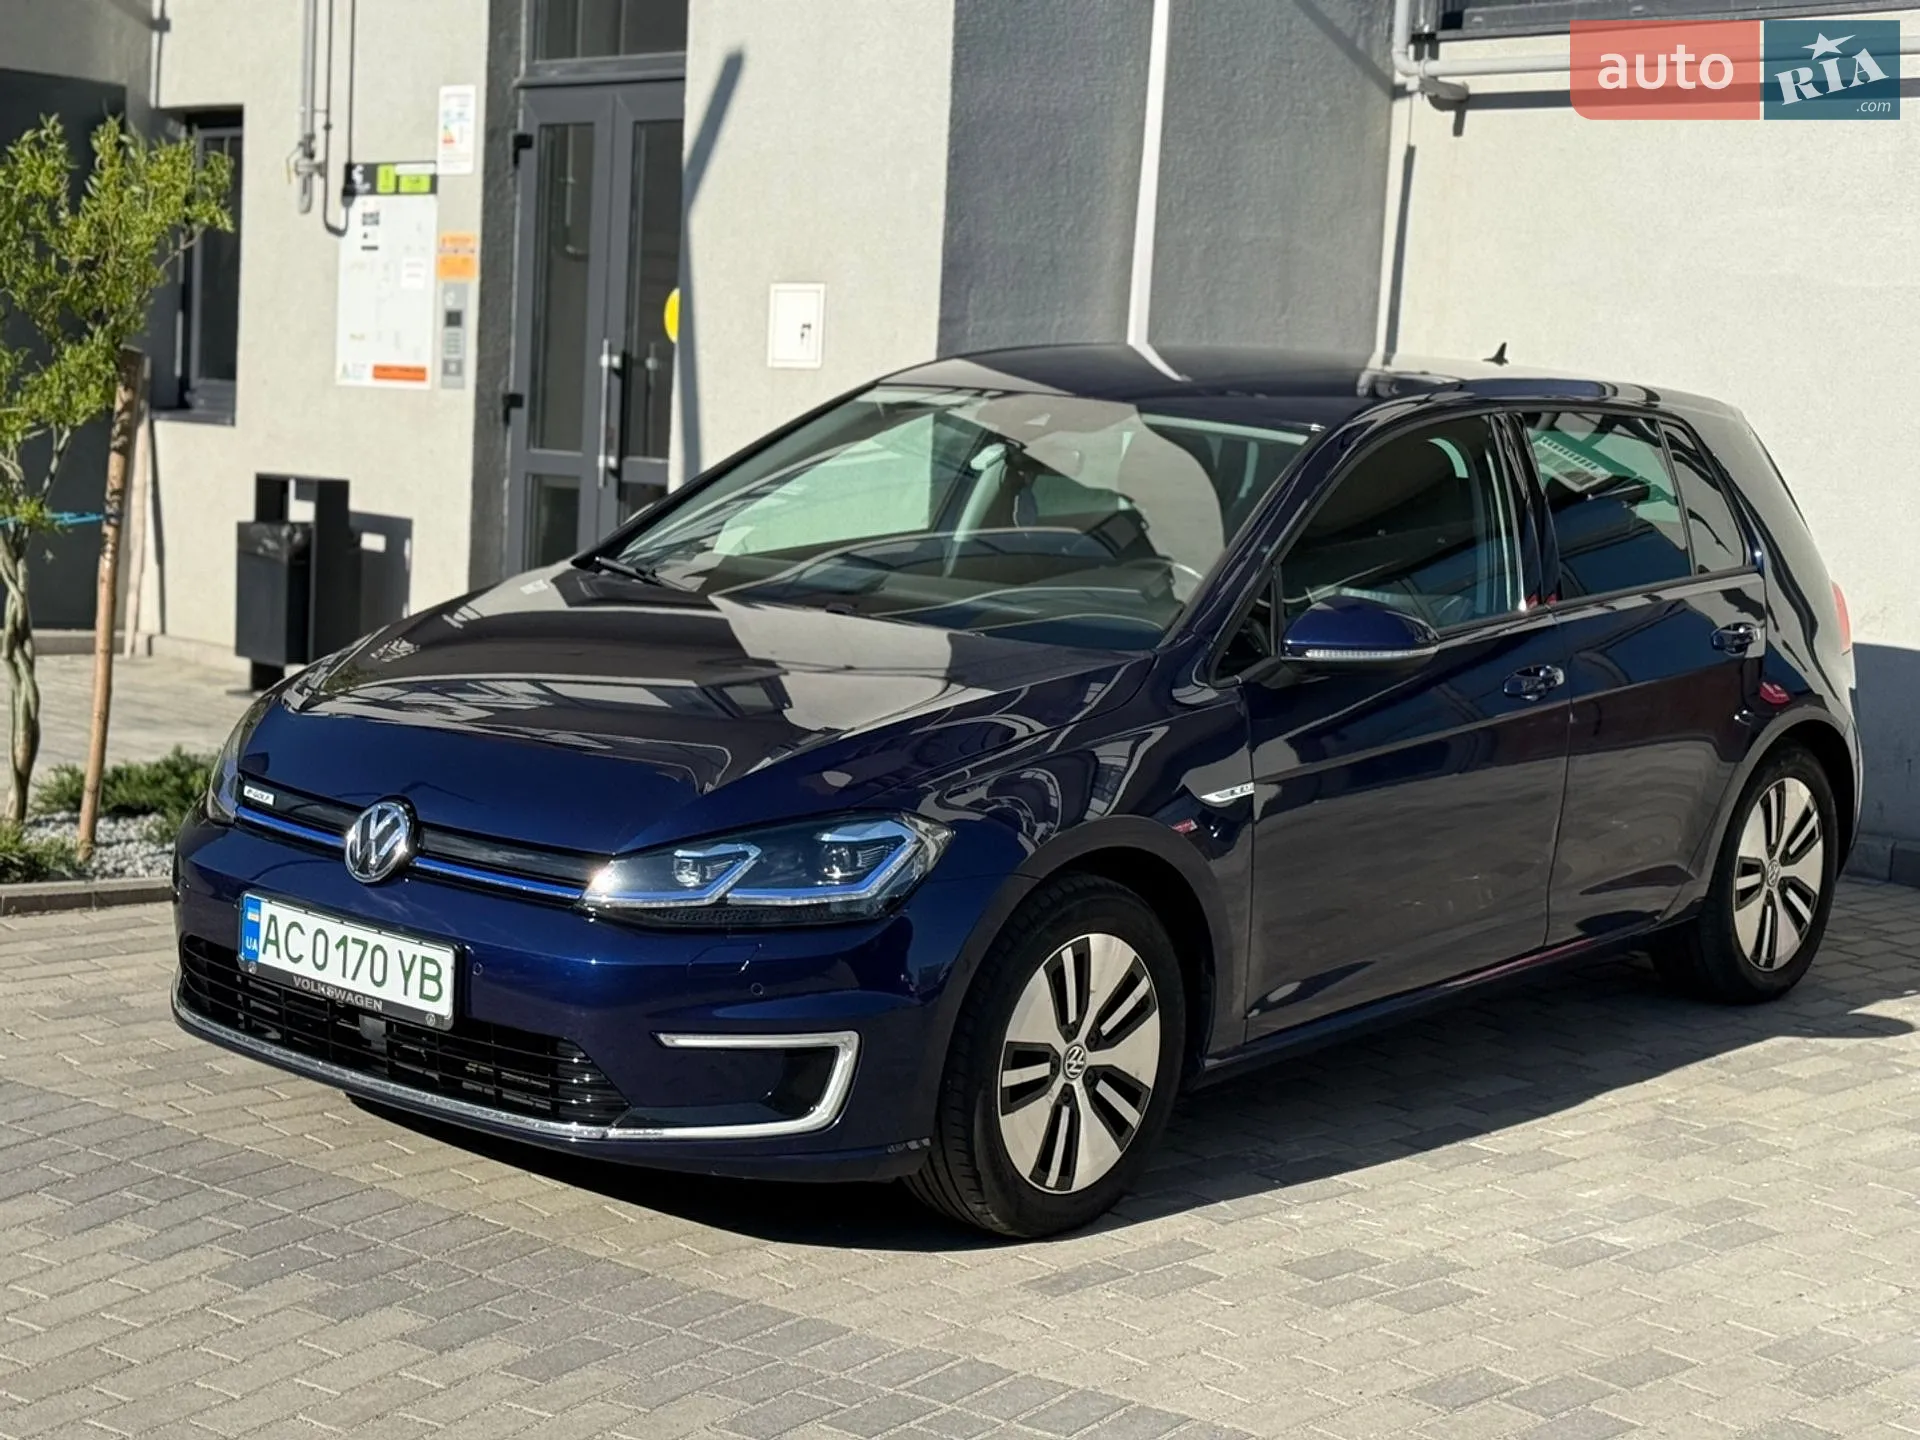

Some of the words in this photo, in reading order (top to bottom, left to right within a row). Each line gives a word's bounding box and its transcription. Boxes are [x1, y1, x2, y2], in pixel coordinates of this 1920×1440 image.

[245, 936, 259, 952] UA
[262, 913, 306, 964] AC
[312, 928, 388, 988] 0170
[398, 949, 443, 1003] YB
[292, 975, 383, 1012] VOLKSWAGEN
